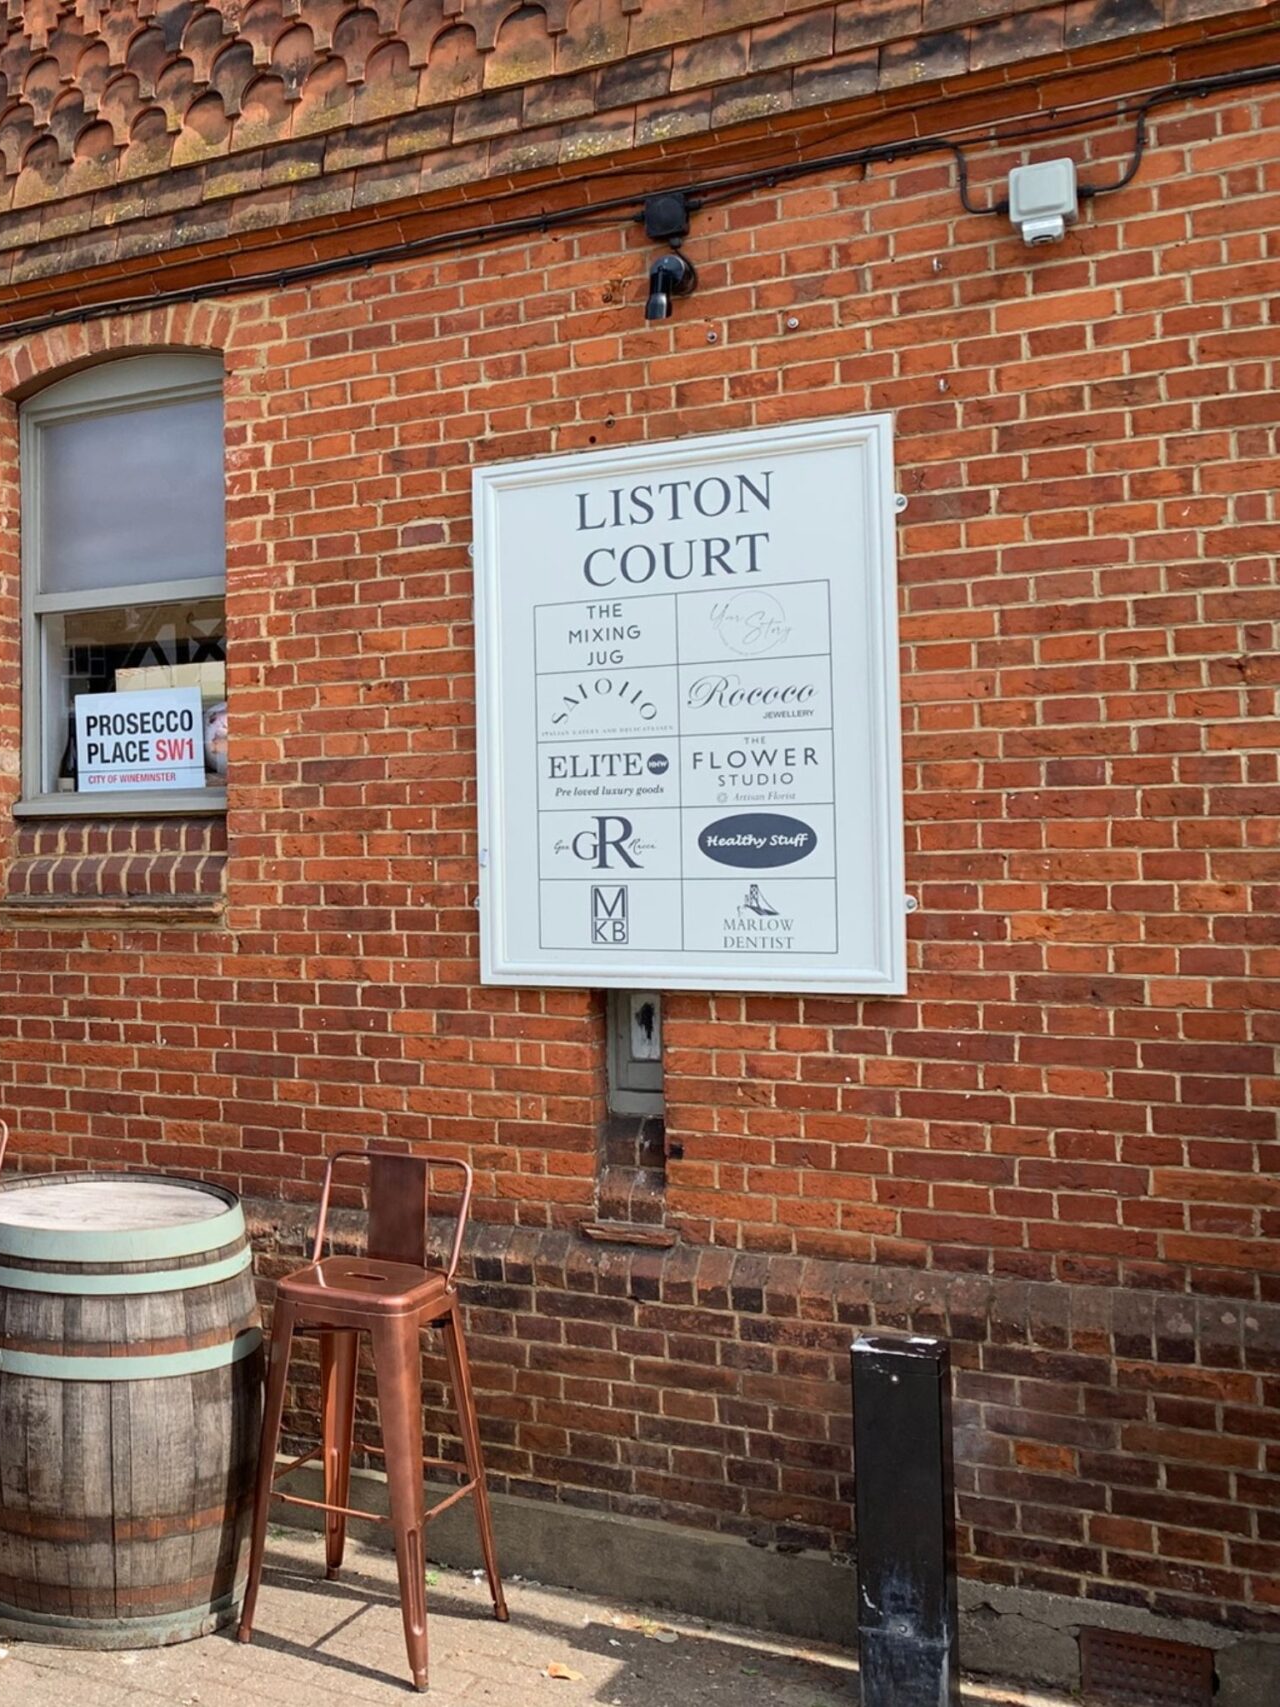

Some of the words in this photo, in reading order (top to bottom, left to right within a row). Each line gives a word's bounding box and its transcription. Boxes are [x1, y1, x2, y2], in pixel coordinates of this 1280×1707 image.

[576, 471, 774, 531] LISTON
[583, 532, 770, 587] COURT
[586, 603, 623, 619] THE
[569, 625, 641, 644] MIXING
[587, 649, 624, 666] JUG
[687, 674, 818, 709] Rococo
[86, 709, 194, 737] PROSECCO
[762, 709, 815, 720] JEWELLERY
[743, 736, 766, 745] THE
[87, 740, 150, 765] PLACE
[155, 738, 195, 762] SW1
[692, 747, 819, 770] FLOWER
[547, 752, 643, 779] ELITE
[88, 774, 106, 785] CITY
[108, 773, 118, 784] OF
[120, 772, 177, 783] WINEMINSTER
[717, 772, 794, 787] STUDIO
[555, 787, 572, 797] Pre
[573, 786, 599, 796] loved
[601, 785, 634, 797] luxury
[635, 784, 664, 796] goods
[706, 833, 767, 849] Healthy
[769, 832, 809, 848] Stuff
[593, 887, 626, 918] M
[594, 921, 626, 942] KB
[723, 918, 795, 932] MARLOW
[723, 936, 795, 949] DENTIST
